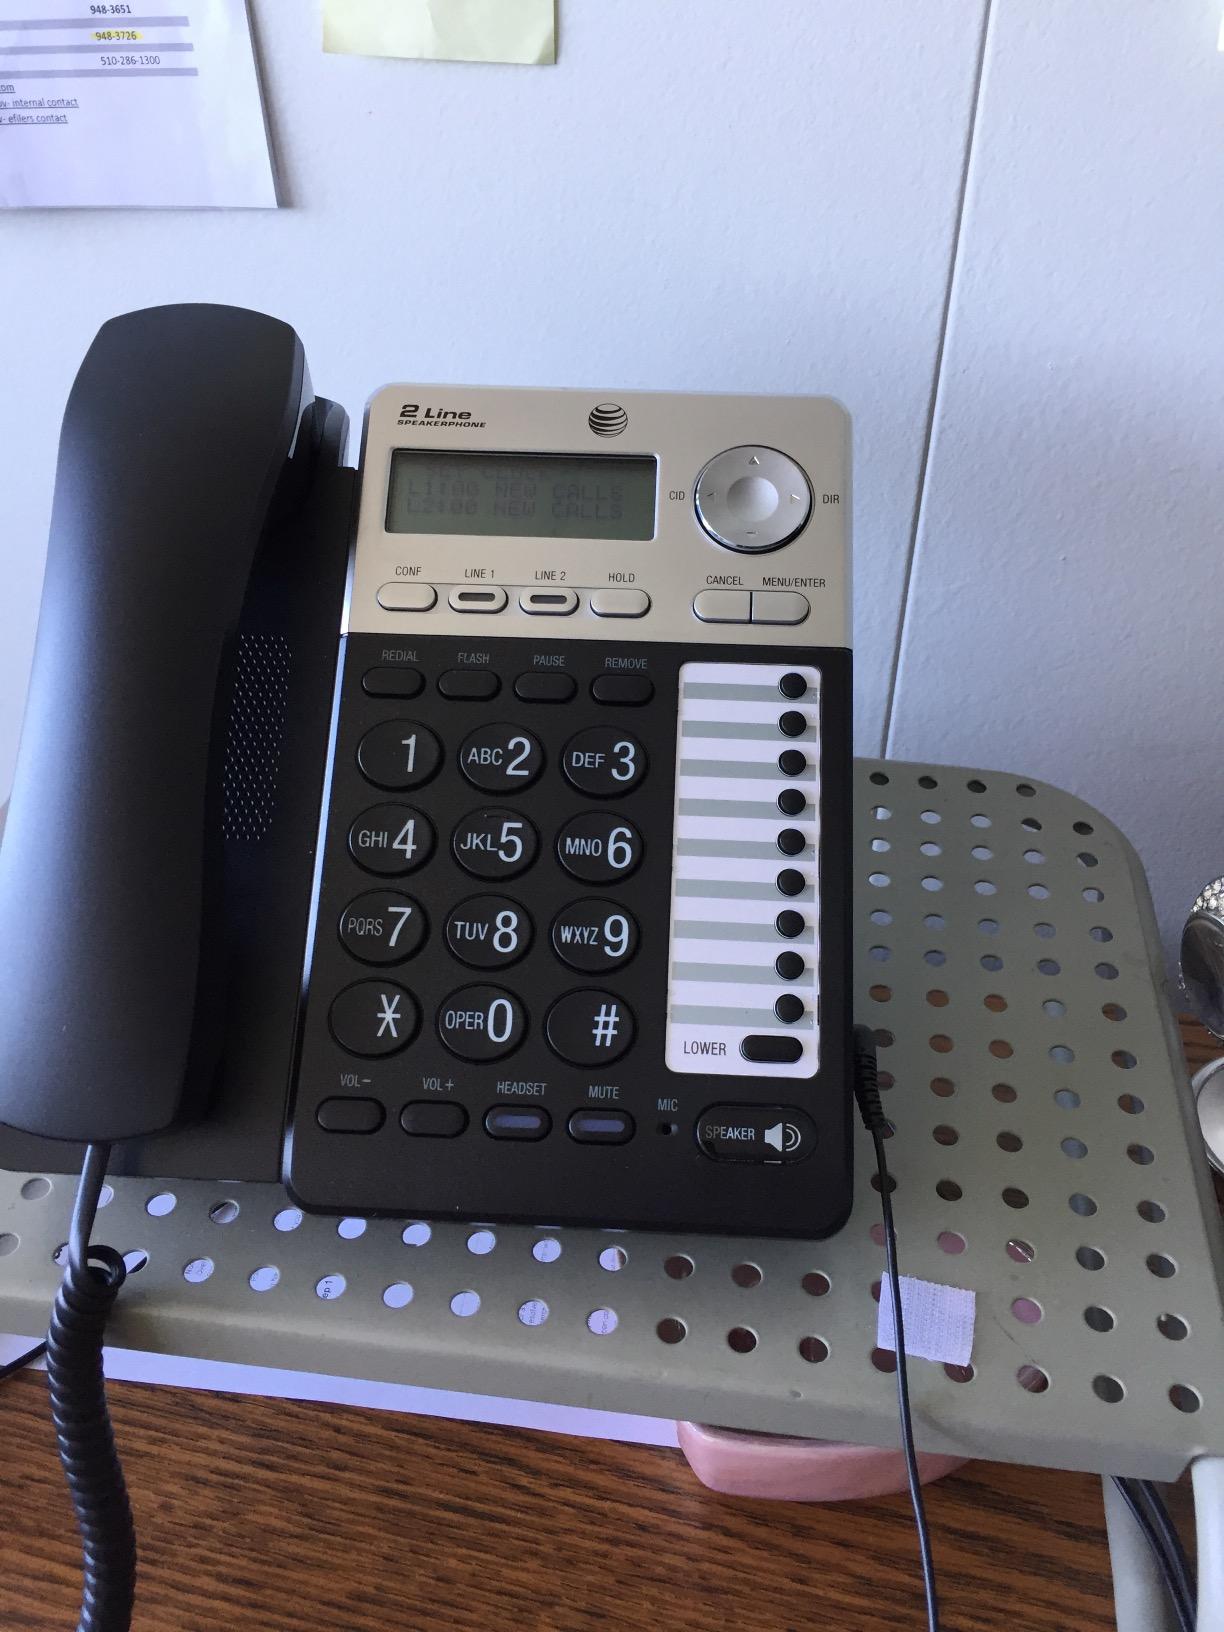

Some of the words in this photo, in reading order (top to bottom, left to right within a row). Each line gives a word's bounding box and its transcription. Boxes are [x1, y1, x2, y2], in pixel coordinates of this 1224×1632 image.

[90, 5, 131, 14] 948-3651
[96, 31, 137, 40] 948-3726
[100, 56, 160, 65] 510-286-1300
[12, 98, 45, 107] internal
[47, 98, 78, 107] contact
[8, 114, 35, 123] efilers
[36, 114, 68, 122] contact
[400, 404, 420, 418] 2
[424, 408, 472, 420] Line
[397, 420, 486, 428] SPEAKERPHONE
[669, 491, 685, 500] CID
[822, 494, 840, 504] DIR
[395, 566, 422, 576] CONF
[465, 569, 486, 578] LINE
[491, 570, 494, 579] 1
[535, 571, 557, 581] LINE
[559, 572, 566, 581] 2
[608, 572, 635, 583] HOLD
[706, 576, 744, 586] CANCEL
[762, 577, 826, 588] MENU/ENTER
[382, 650, 419, 662] REDIAL
[458, 653, 489, 664] FLASH
[534, 655, 565, 666] PAUSE
[605, 657, 647, 669] REMOVE
[402, 734, 416, 772] 1
[468, 748, 503, 765] ABC
[506, 737, 531, 775] 2
[572, 752, 605, 768] DEF
[611, 741, 635, 781] 3
[358, 830, 387, 848] GHI
[392, 819, 417, 859] 4
[460, 833, 498, 851] JKL
[498, 822, 523, 862] 5
[565, 837, 602, 856] MNO
[607, 827, 632, 868] 6
[348, 918, 383, 936] PQRS
[387, 907, 411, 947] 7
[454, 922, 489, 941] TUV
[492, 910, 518, 953] 8
[561, 926, 599, 945] WXYZ
[604, 915, 629, 956] 9
[445, 1011, 483, 1030] OPER
[487, 999, 513, 1042] 0
[592, 1004, 619, 1046] #
[684, 1041, 726, 1056] LOWER
[497, 1082, 547, 1095] HEADSET
[588, 1086, 619, 1098] MUTE
[658, 1099, 678, 1111] MIC
[705, 1126, 755, 1141] SPEAKER
